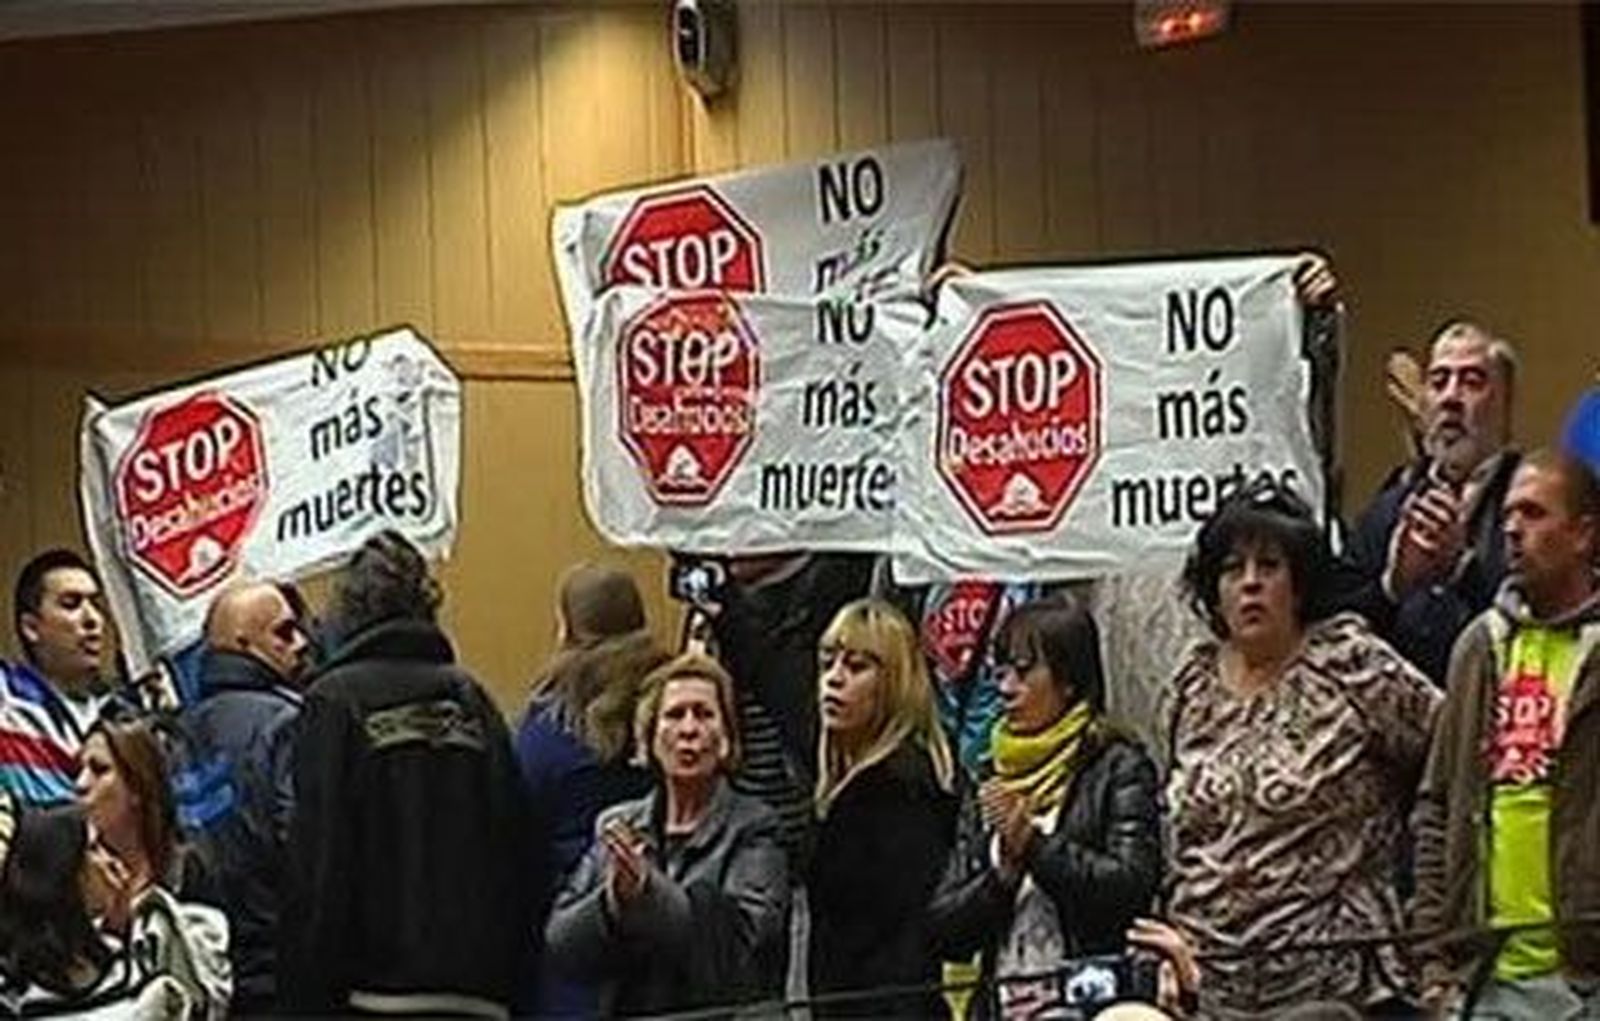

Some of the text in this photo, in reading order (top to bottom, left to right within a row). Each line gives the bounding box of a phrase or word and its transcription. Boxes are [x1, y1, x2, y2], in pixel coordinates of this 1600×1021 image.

[819, 157, 883, 224] NO
[622, 231, 739, 290] STOP
[818, 301, 874, 344] NO
[1166, 287, 1234, 354] NO
[311, 339, 371, 386] NO
[633, 331, 740, 385] STOP
[963, 350, 1077, 418] STOP
[310, 389, 385, 462] más
[803, 362, 876, 428] más
[1158, 370, 1247, 440] más
[133, 417, 241, 502] STOP
[760, 453, 896, 510] muerte
[276, 463, 426, 542] muertes
[943, 598, 988, 631] STO
